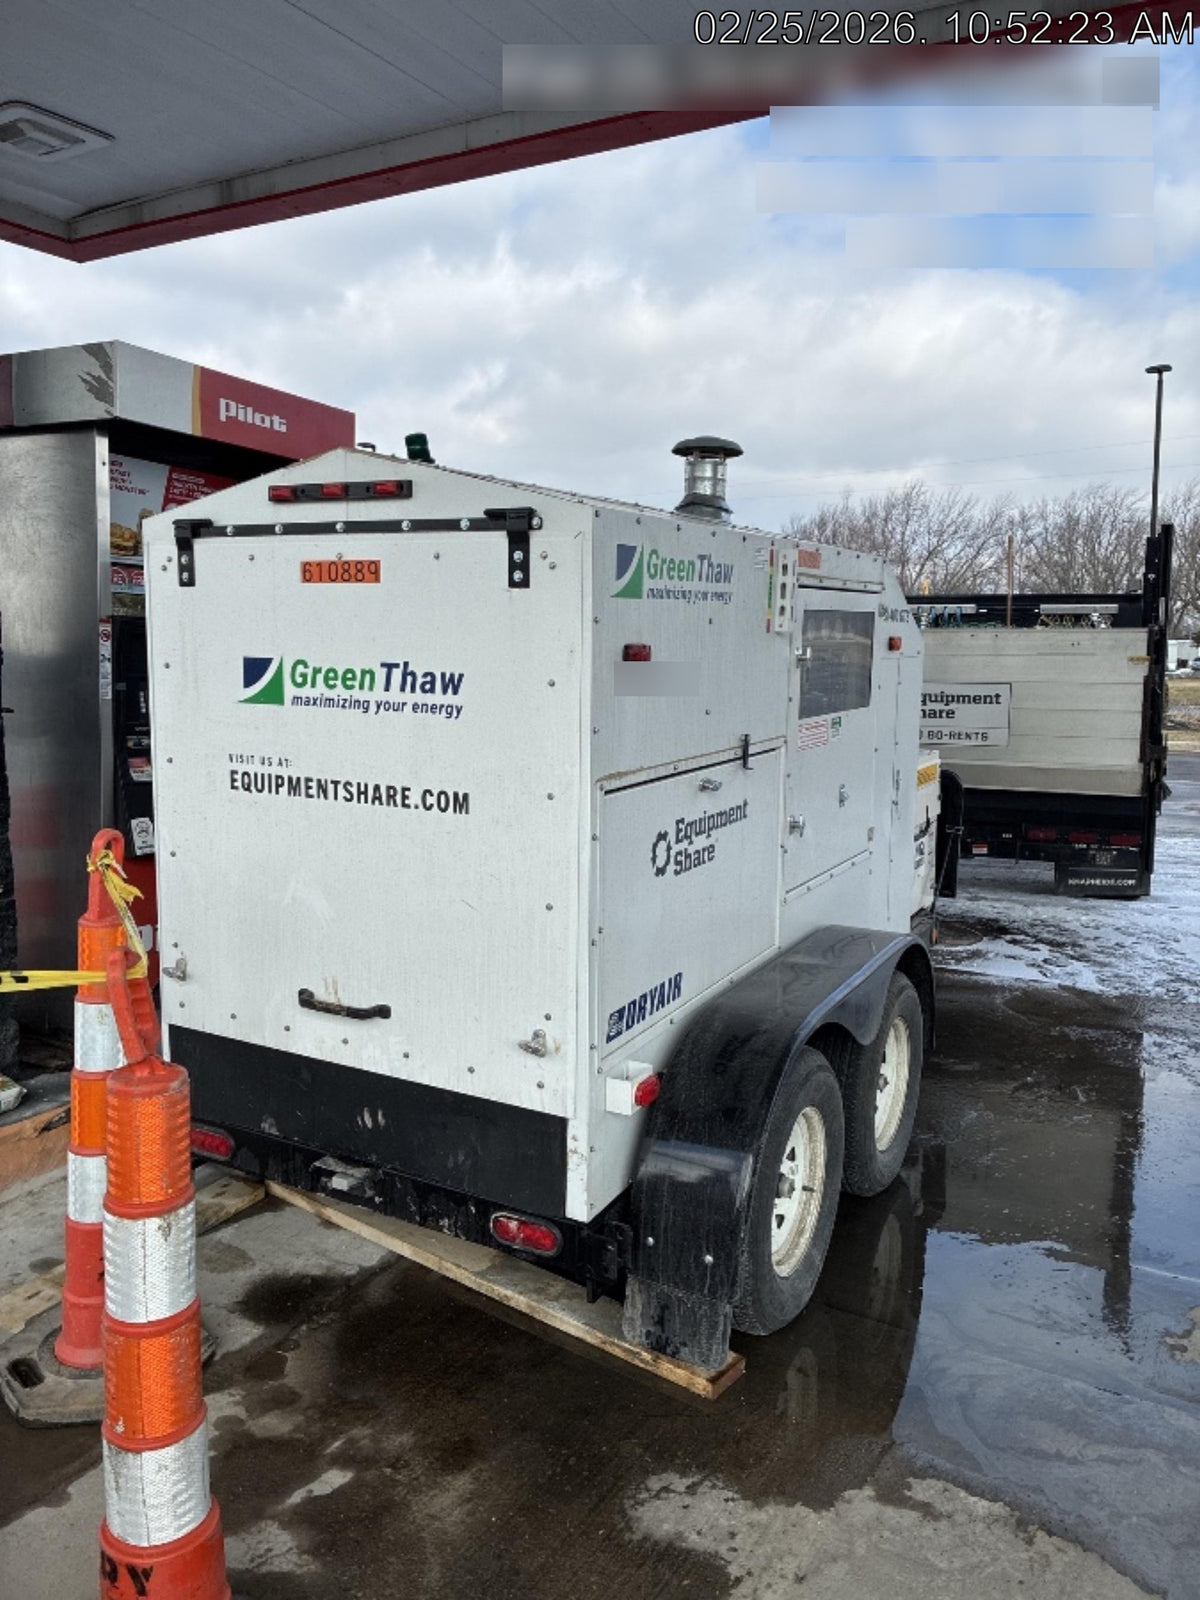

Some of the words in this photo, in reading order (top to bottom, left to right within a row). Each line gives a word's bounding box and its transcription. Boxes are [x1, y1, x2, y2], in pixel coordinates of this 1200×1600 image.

[219, 397, 287, 433] Pilot
[303, 561, 378, 582] 610889
[291, 693, 370, 713] maximizing
[374, 699, 407, 715] your
[411, 701, 463, 719] energy
[921, 691, 1002, 706] quipment
[228, 753, 255, 764] VISIT
[259, 755, 273, 766] US
[277, 758, 293, 768] AT:
[229, 769, 470, 815] EQUIPMENTSHARE.COM
[674, 798, 749, 846] Equipment
[673, 844, 716, 876] Share
[625, 971, 683, 1032] DRYAIR
